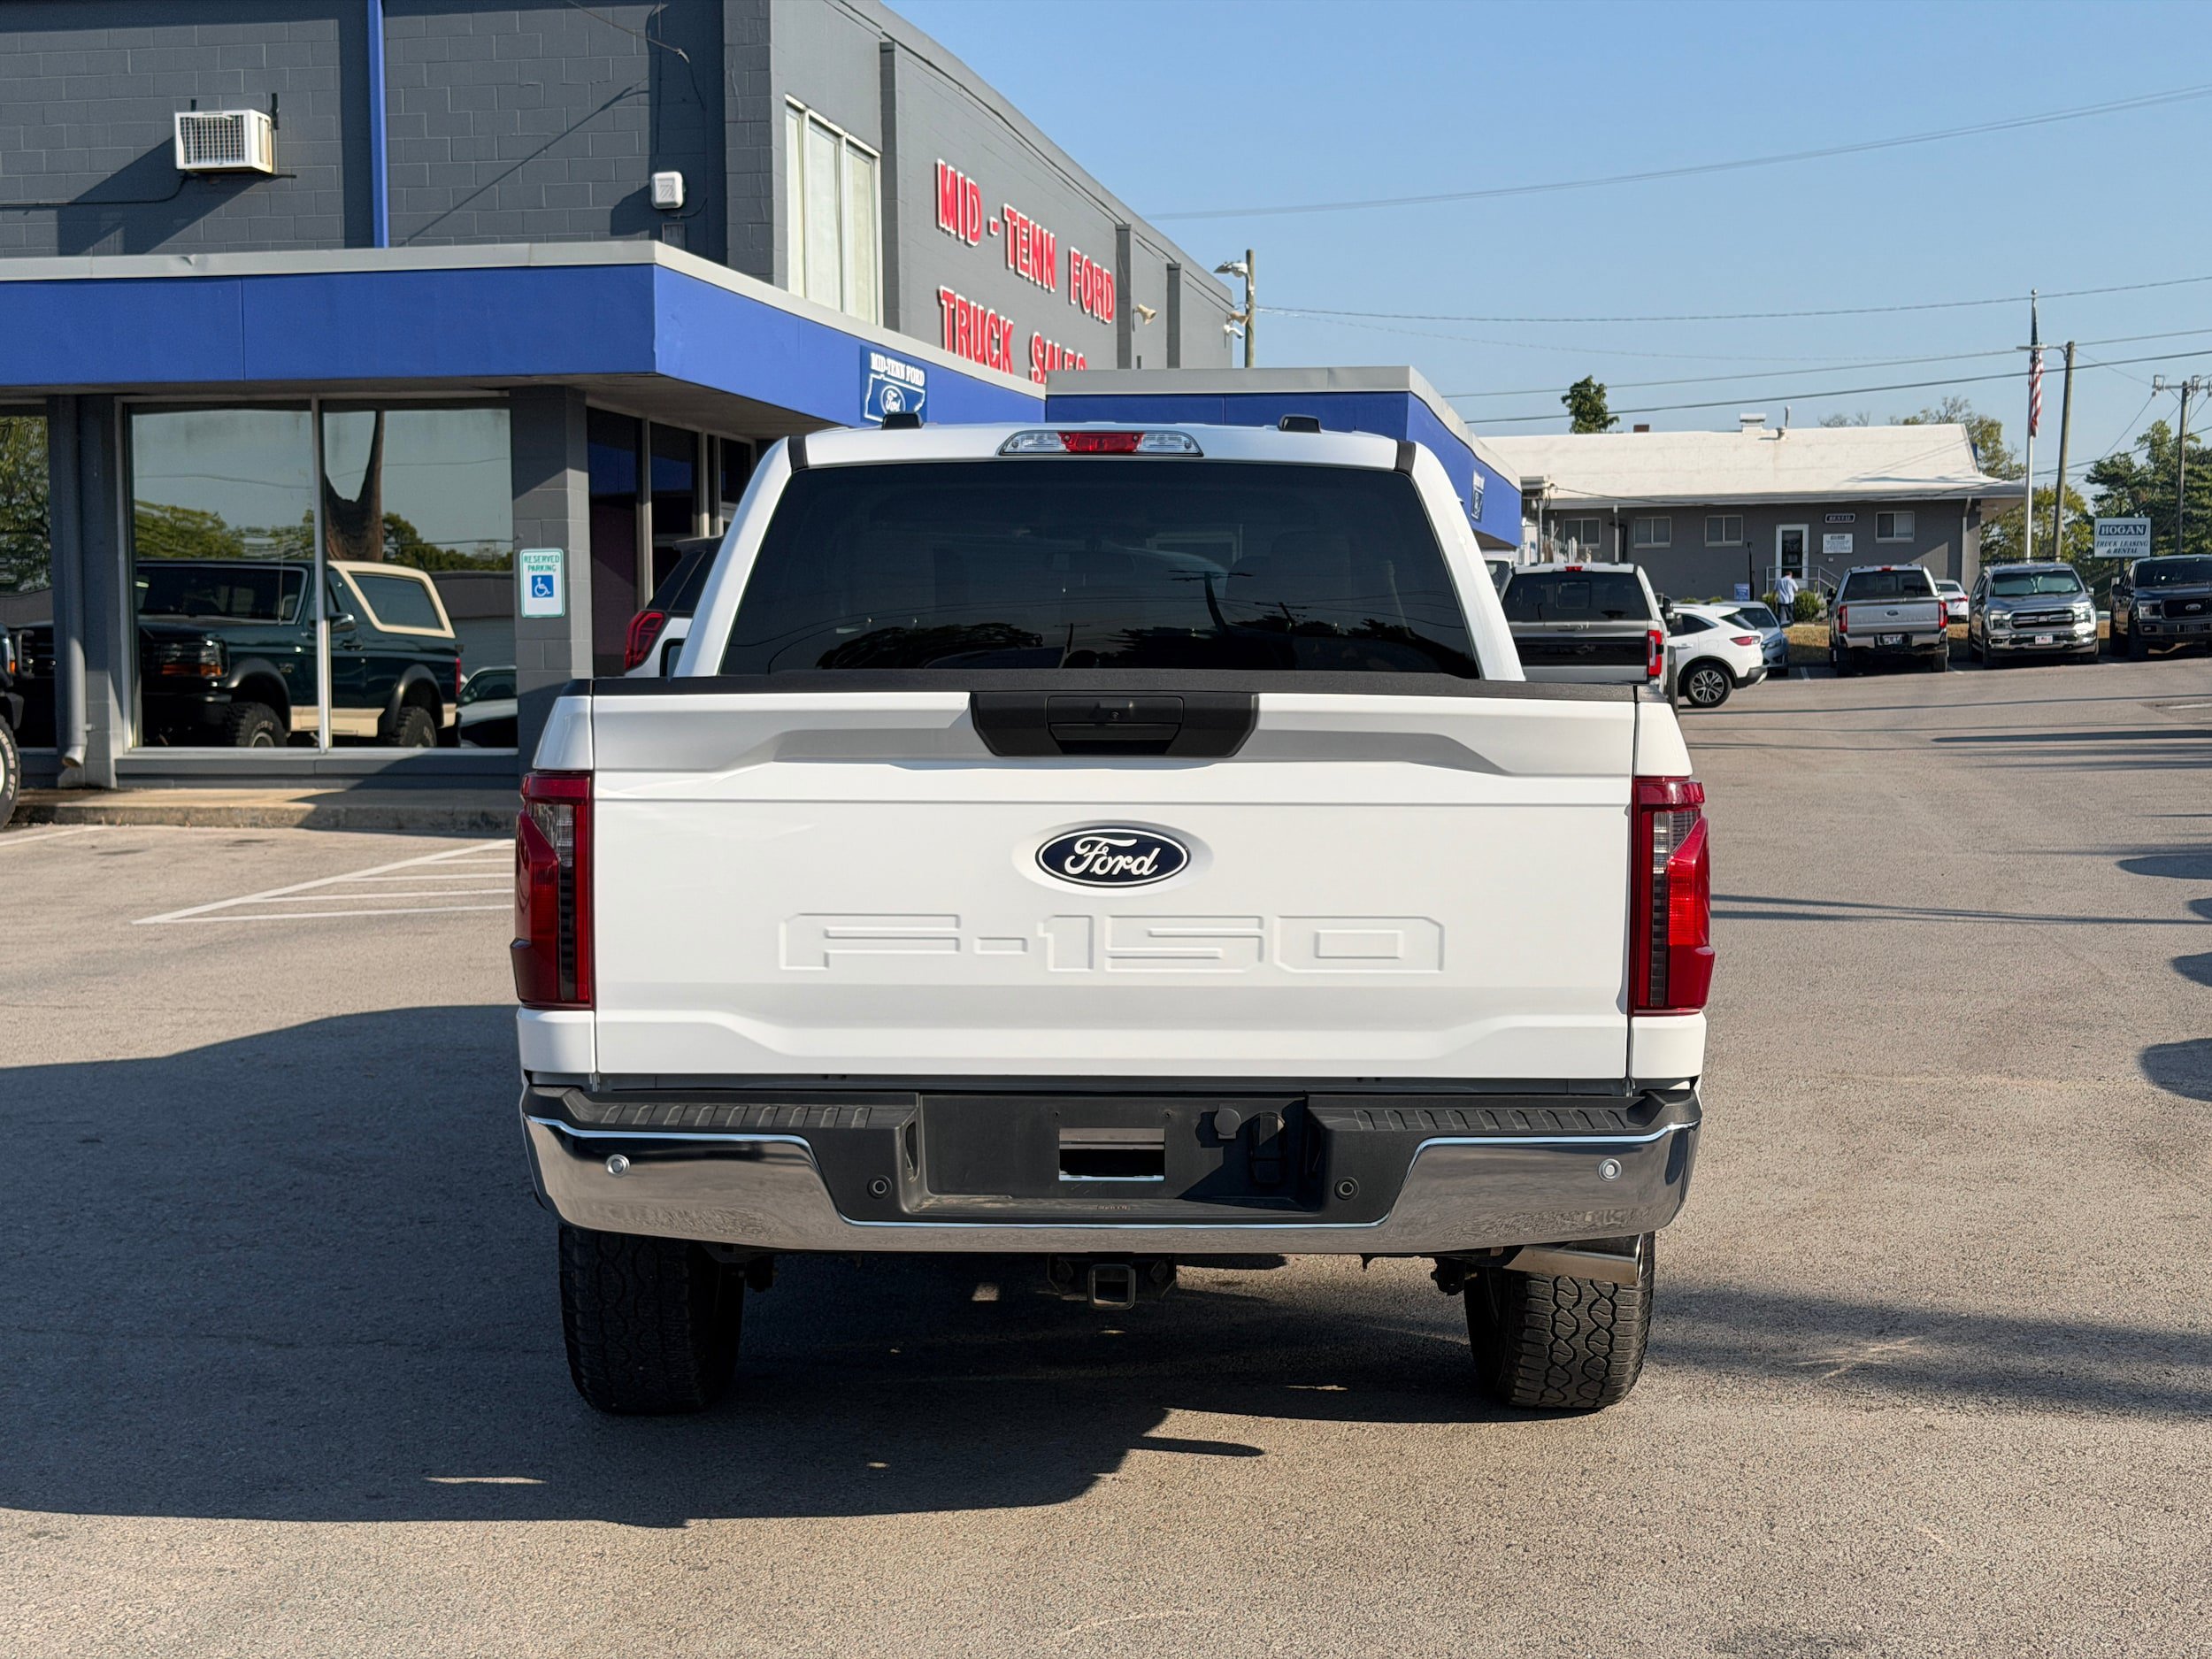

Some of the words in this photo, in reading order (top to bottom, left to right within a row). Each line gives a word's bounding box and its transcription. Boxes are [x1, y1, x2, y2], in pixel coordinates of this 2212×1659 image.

[938, 158, 981, 246] MID
[1003, 203, 1056, 292] TENN
[1070, 246, 1115, 323] FORD
[940, 285, 1014, 375] TRUCK
[906, 364, 926, 387] FORD
[2101, 525, 2145, 535] HOGAN
[523, 555, 560, 564] RESERVED
[527, 564, 557, 572] PARKING
[1064, 836, 1161, 876] Ford
[778, 913, 1445, 973] F-150
